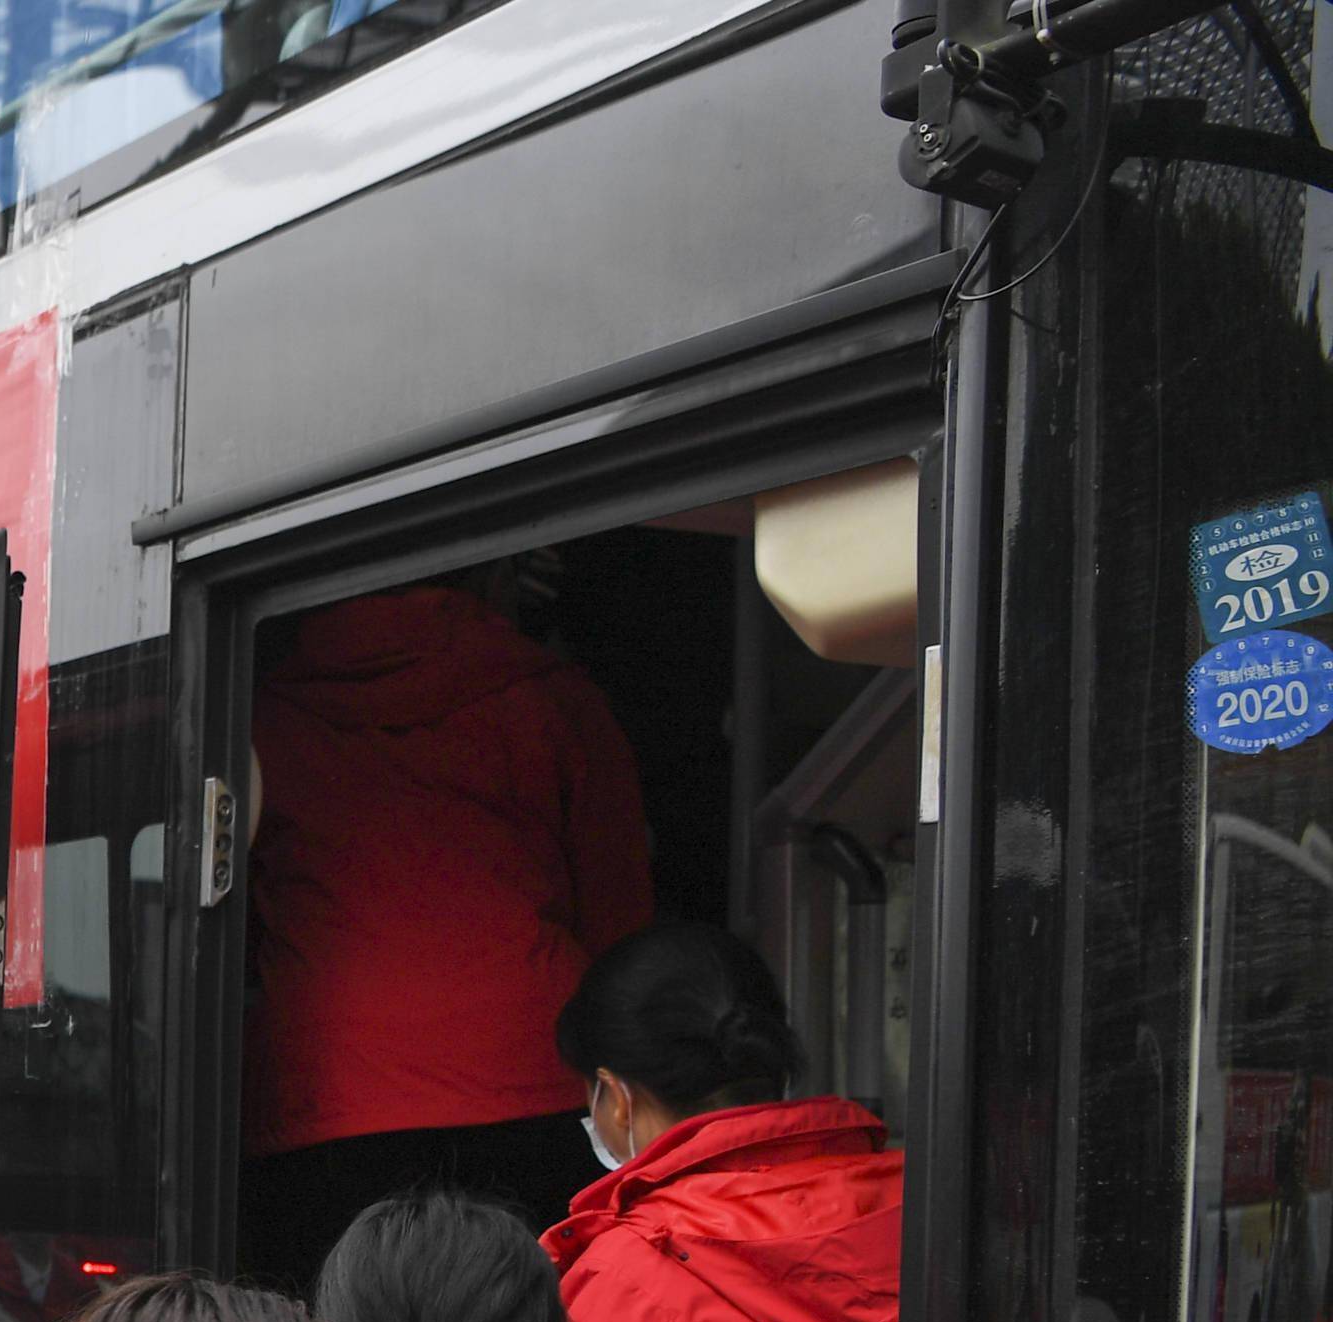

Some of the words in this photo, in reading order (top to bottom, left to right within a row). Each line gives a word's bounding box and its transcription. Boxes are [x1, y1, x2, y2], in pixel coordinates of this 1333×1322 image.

[1240, 550, 1286, 577] 检
[1214, 570, 1330, 633] 2019
[1216, 680, 1309, 728] 2020
